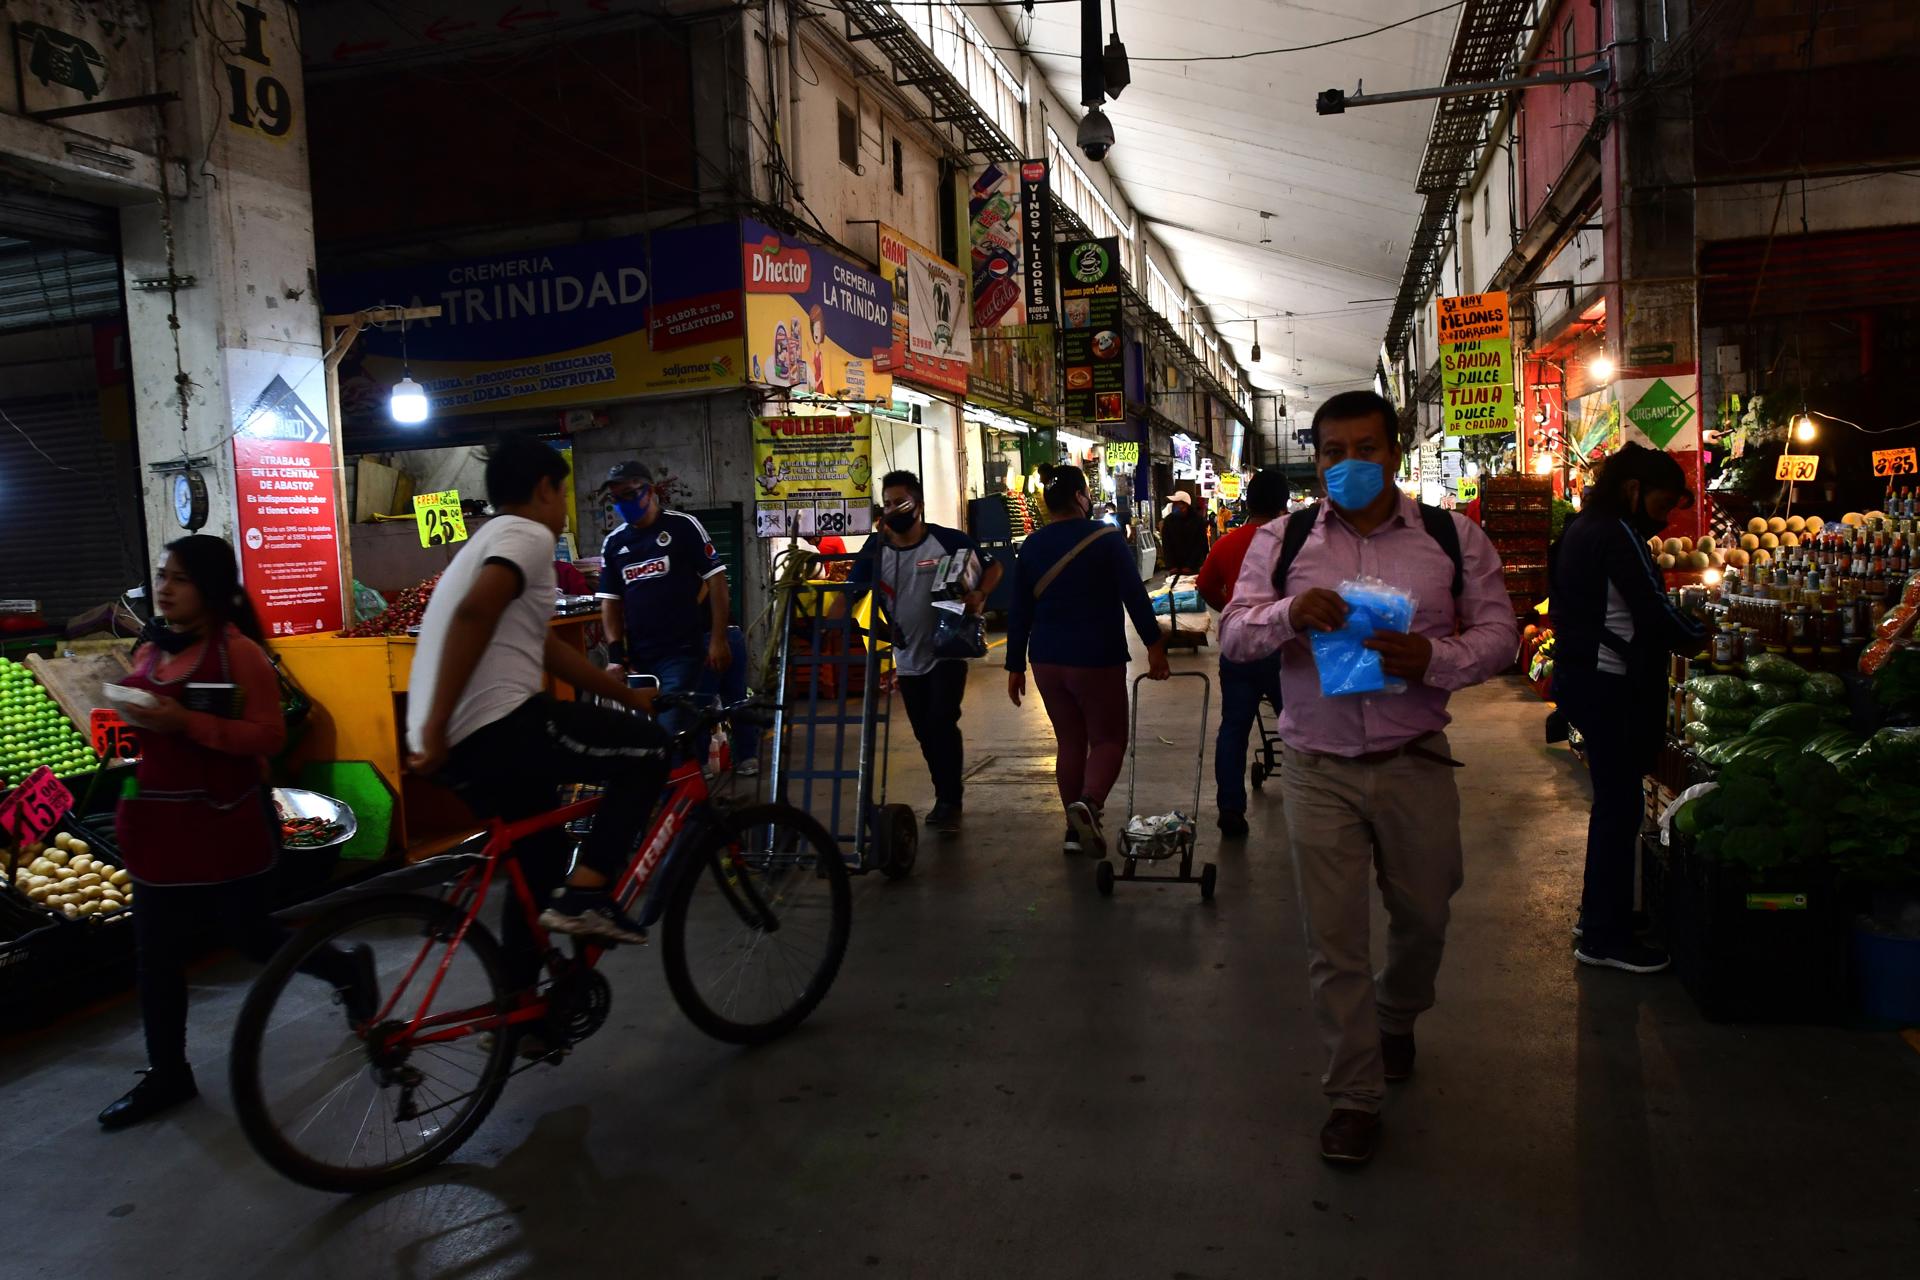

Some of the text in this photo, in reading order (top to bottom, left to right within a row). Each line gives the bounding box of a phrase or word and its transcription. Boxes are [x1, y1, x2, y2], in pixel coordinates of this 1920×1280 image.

[225, 64, 291, 136] 19
[1029, 184, 1041, 228] VINOS
[1031, 231, 1041, 240] Y
[447, 256, 555, 285] CREMERIA
[1032, 243, 1044, 305] LICORES
[833, 264, 877, 298] CREMERIA
[440, 266, 649, 326] TRINIDAD
[823, 281, 839, 309] LA
[840, 288, 888, 326] TRINIDAD
[1442, 295, 1483, 312] SI HAY
[652, 303, 721, 329] EL SABOR DE TU
[668, 310, 735, 336] CREATIVIDAD
[1440, 308, 1504, 331] MELONES
[476, 364, 540, 385] PRODUCTOS
[544, 353, 612, 373] MEXICANOS
[1445, 351, 1501, 370] SANDIA
[473, 385, 511, 401] IDEAS
[513, 385, 537, 395] PARA
[541, 367, 615, 390] DISFRUTAR
[1457, 369, 1499, 383] DULCE
[1448, 386, 1503, 406] TUNA
[1455, 406, 1496, 420] DULCE
[1631, 405, 1681, 421] ORGANICO
[1450, 418, 1508, 431] DE CALIDAD
[1106, 442, 1135, 452] HUEVO
[1108, 452, 1137, 460] FRESCO
[251, 468, 320, 479] EN LA CENTRAL
[259, 480, 314, 491] DE ABASTO?
[246, 495, 257, 503] Es
[258, 495, 307, 504] indispensable
[266, 506, 288, 514] tienes
[425, 509, 455, 545] 25
[625, 561, 666, 580] BIMBO
